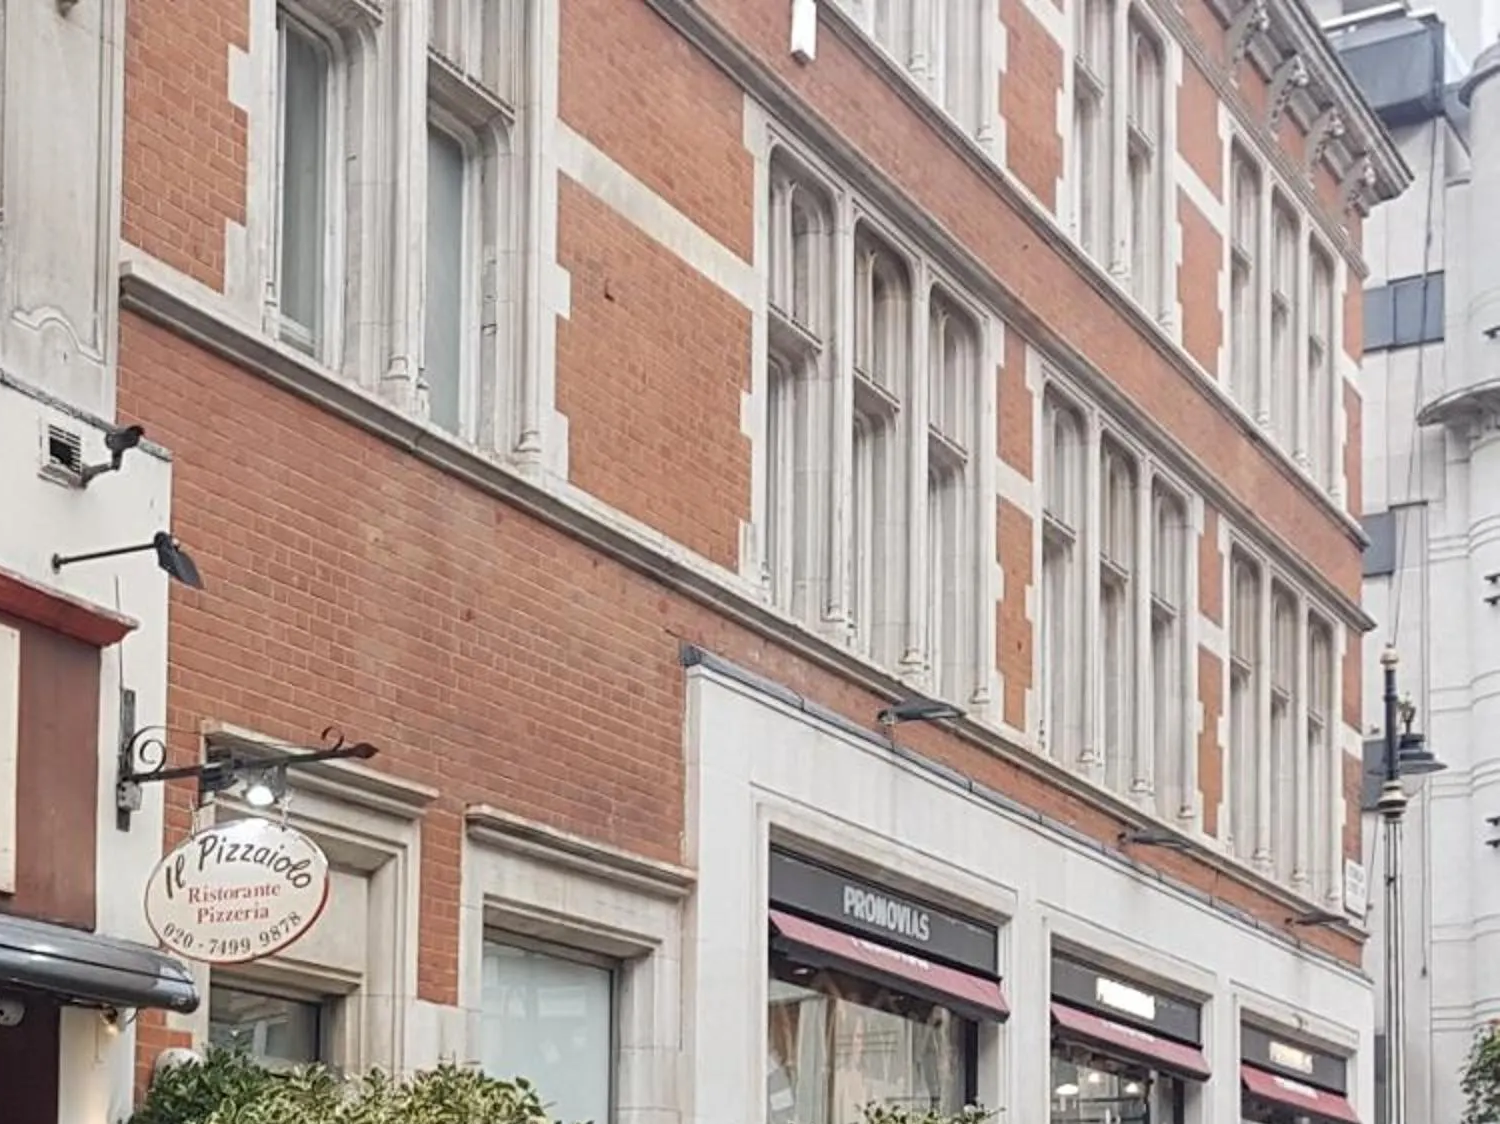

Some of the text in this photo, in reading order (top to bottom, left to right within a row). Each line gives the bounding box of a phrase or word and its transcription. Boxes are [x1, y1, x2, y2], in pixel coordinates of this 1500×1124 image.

[198, 834, 313, 890] Pizzaiolo
[188, 882, 282, 905] Ristorante
[197, 904, 270, 925] Pizzeria
[843, 885, 931, 942] PRONOVIAS
